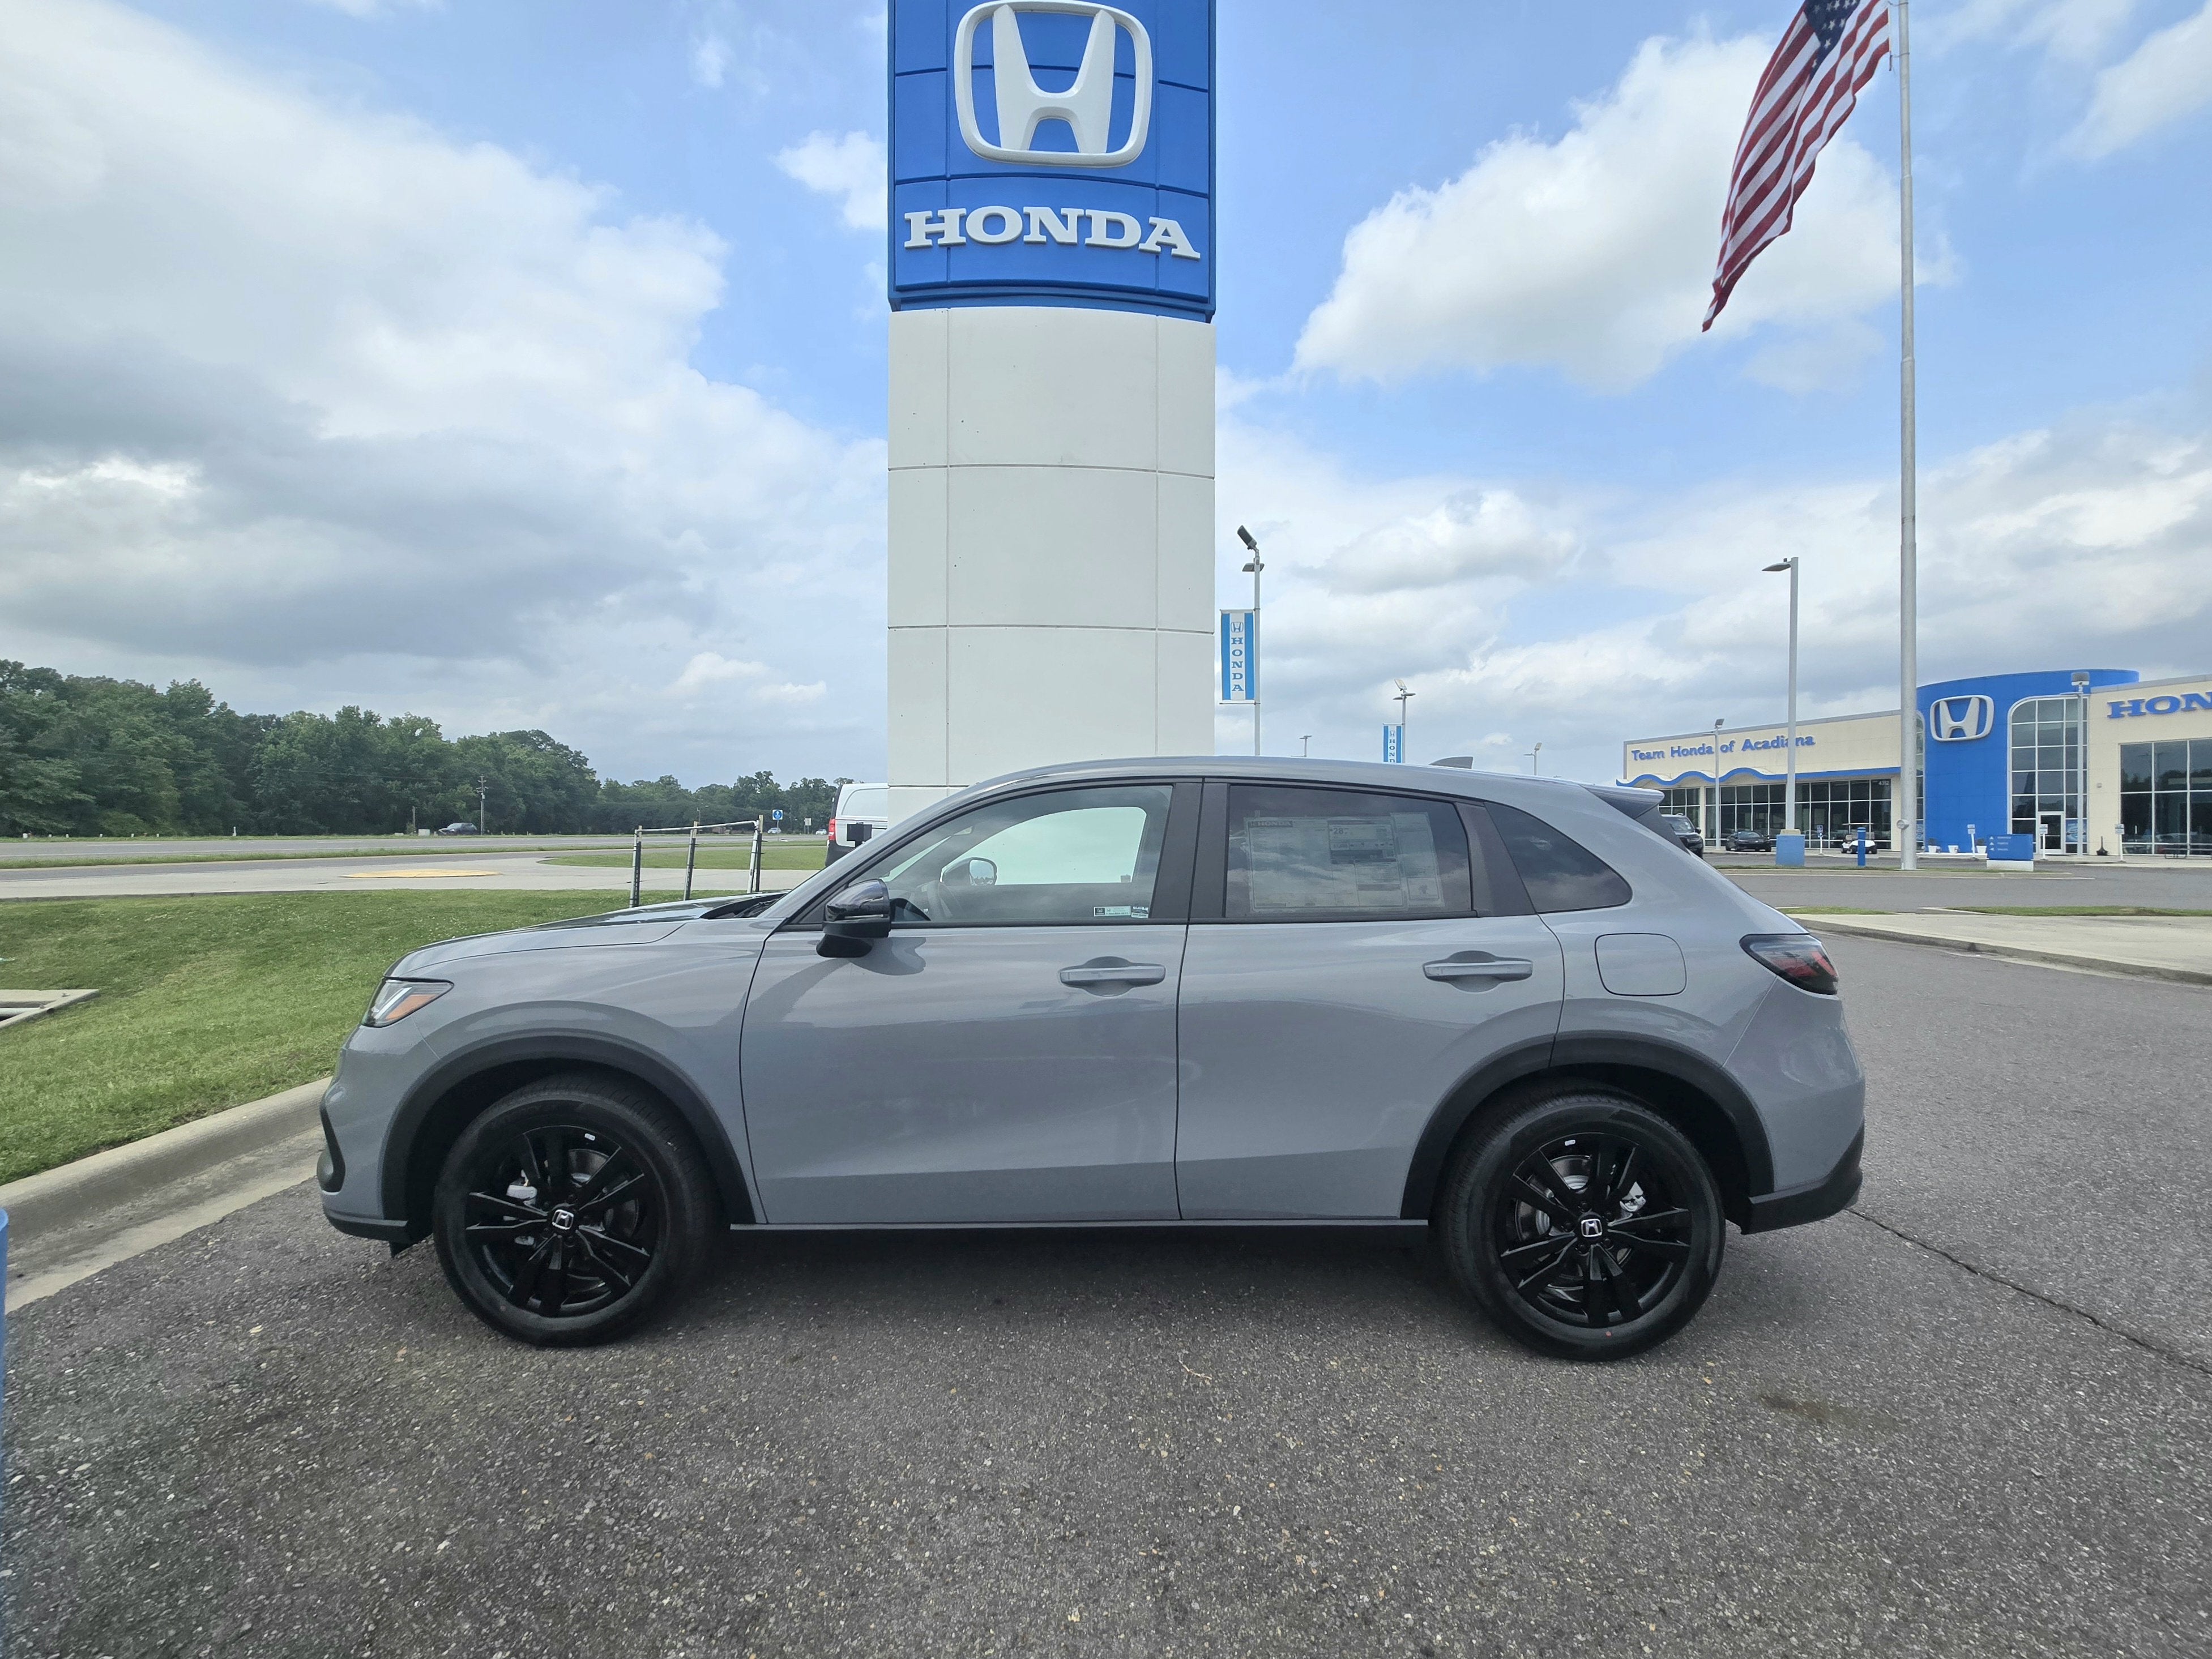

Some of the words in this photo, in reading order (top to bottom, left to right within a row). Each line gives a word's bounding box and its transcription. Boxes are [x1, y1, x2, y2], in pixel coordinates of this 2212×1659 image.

[904, 206, 1201, 260] HONDA
[1231, 637, 1244, 692] HONDA
[1631, 750, 1665, 760] Team
[1671, 743, 1714, 758] Honda
[1720, 740, 1736, 753] of
